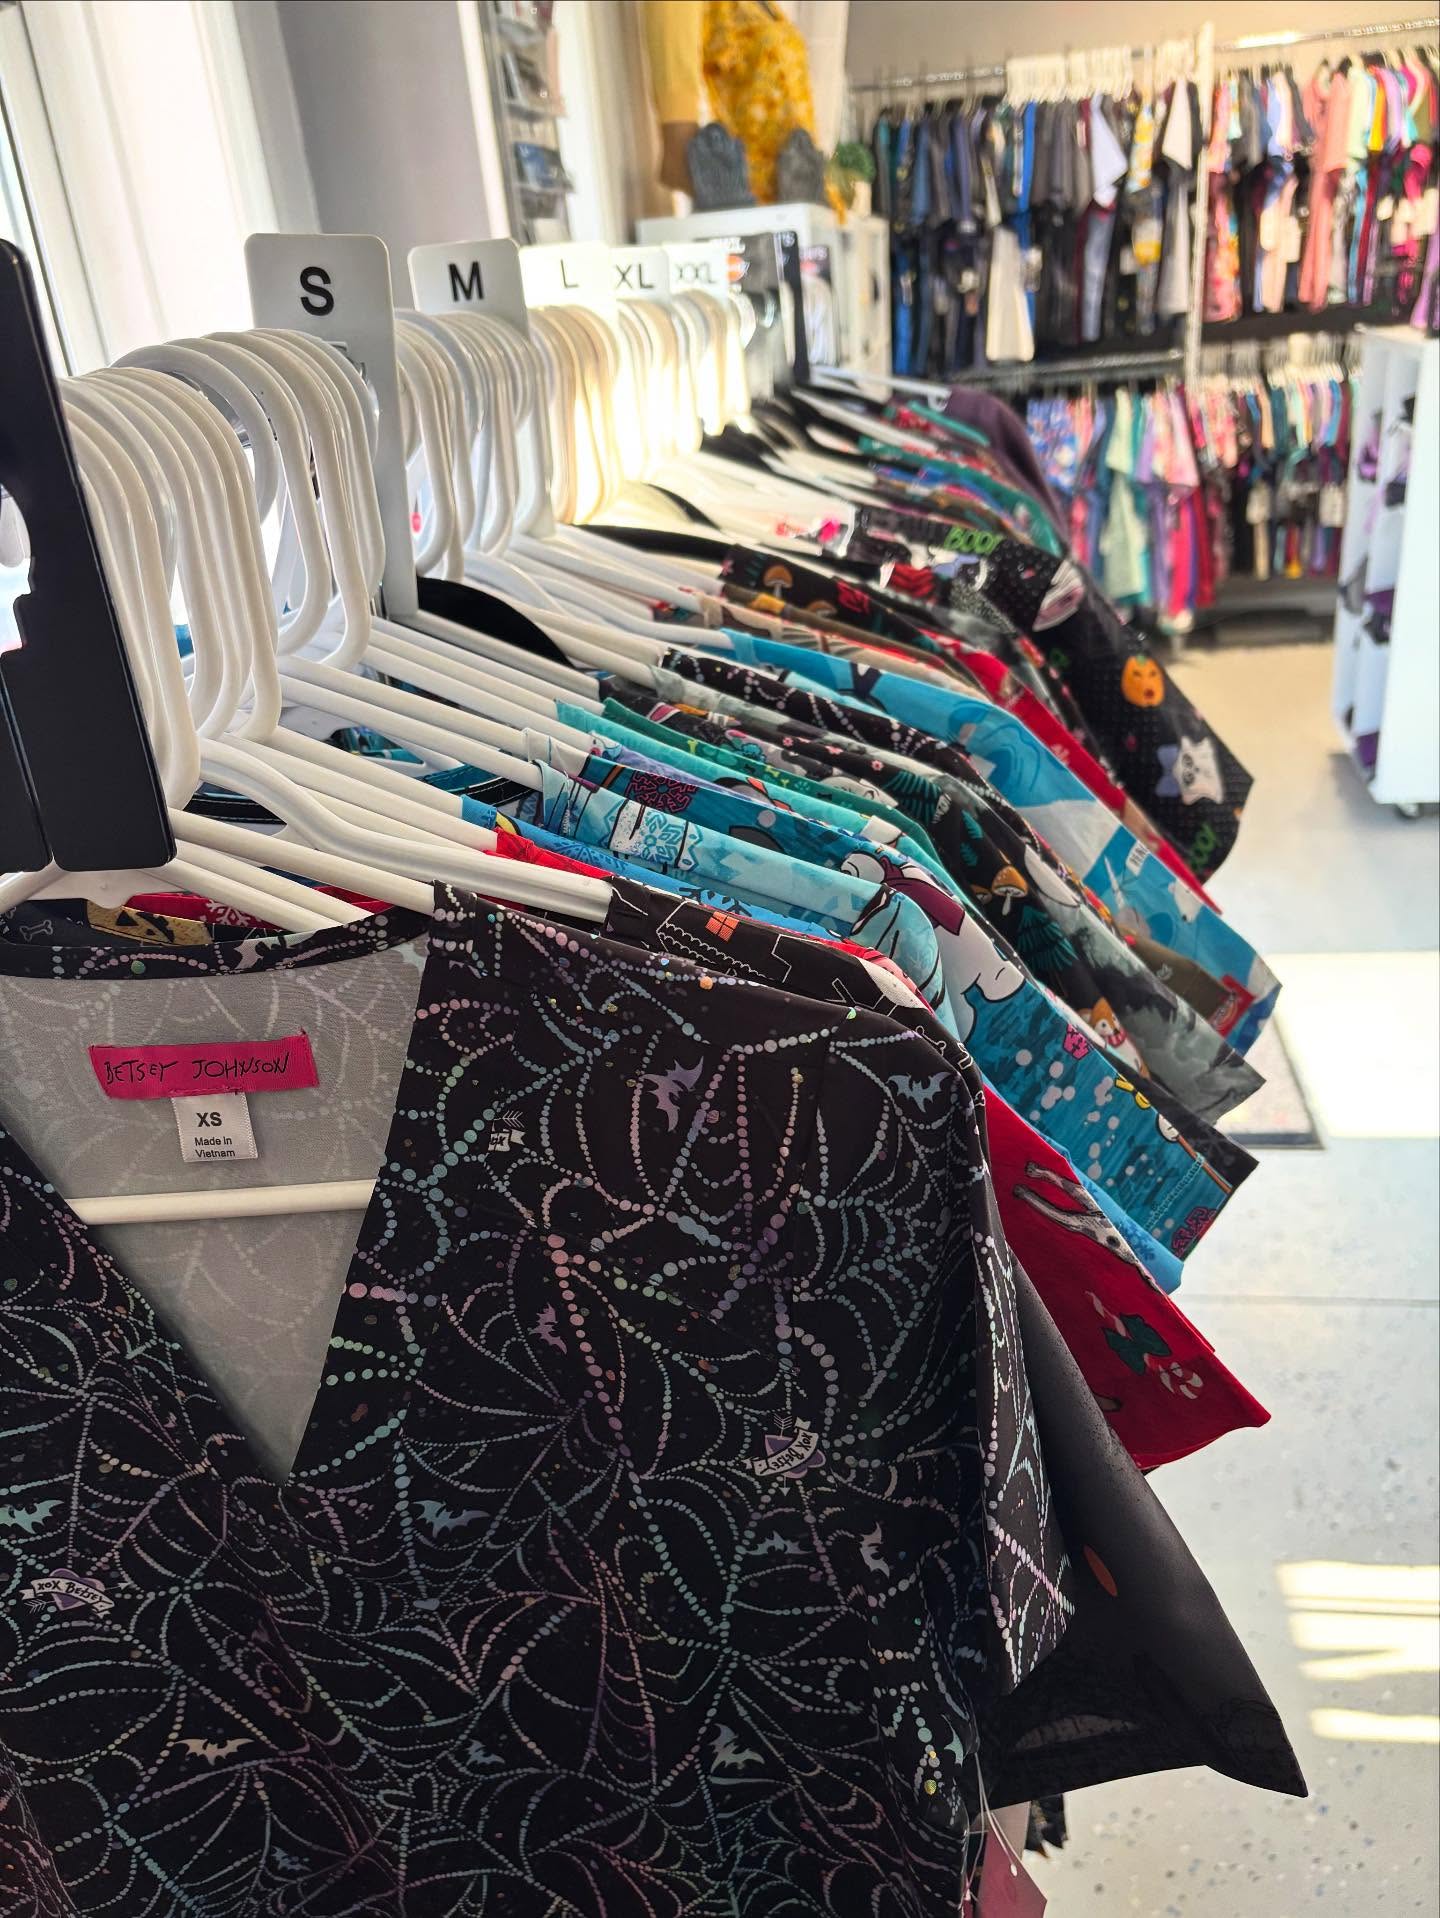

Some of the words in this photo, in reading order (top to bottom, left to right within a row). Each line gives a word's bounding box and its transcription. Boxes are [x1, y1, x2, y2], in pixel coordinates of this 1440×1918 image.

[448, 260, 484, 303] M
[560, 258, 579, 288] L
[615, 263, 654, 289] XL
[674, 261, 717, 285] XXL
[299, 265, 335, 317] S
[104, 1059, 178, 1085] BETSEY
[191, 1051, 290, 1081] JOHNSON
[196, 1111, 222, 1128] XS
[194, 1136, 221, 1147] Made
[195, 1149, 236, 1158] Vietnam
